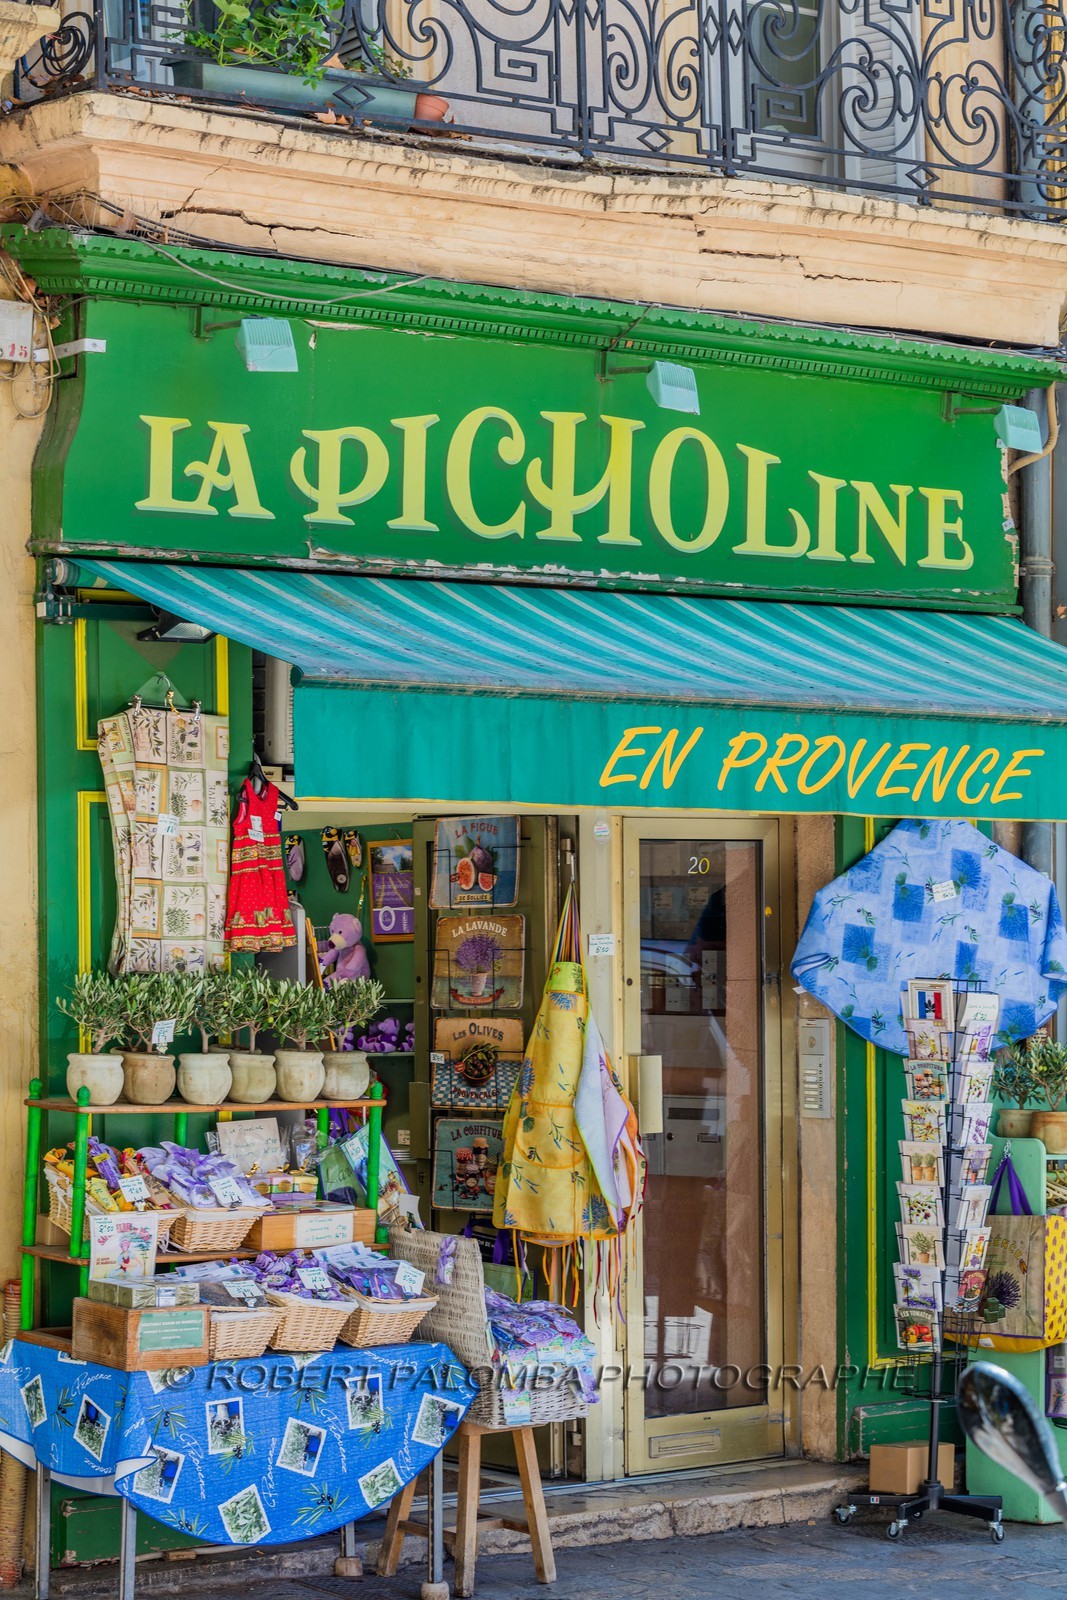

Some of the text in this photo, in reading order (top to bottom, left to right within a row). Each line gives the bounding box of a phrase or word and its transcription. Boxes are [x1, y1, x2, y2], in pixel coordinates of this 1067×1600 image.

[134, 405, 976, 571] LA PICHOLINE
[600, 726, 1045, 805] EN PROVENCE
[454, 822, 500, 839] LA FIGUE
[688, 856, 710, 874] 20
[452, 920, 508, 939] LA LAVANDE
[450, 1129, 463, 1142] LA
